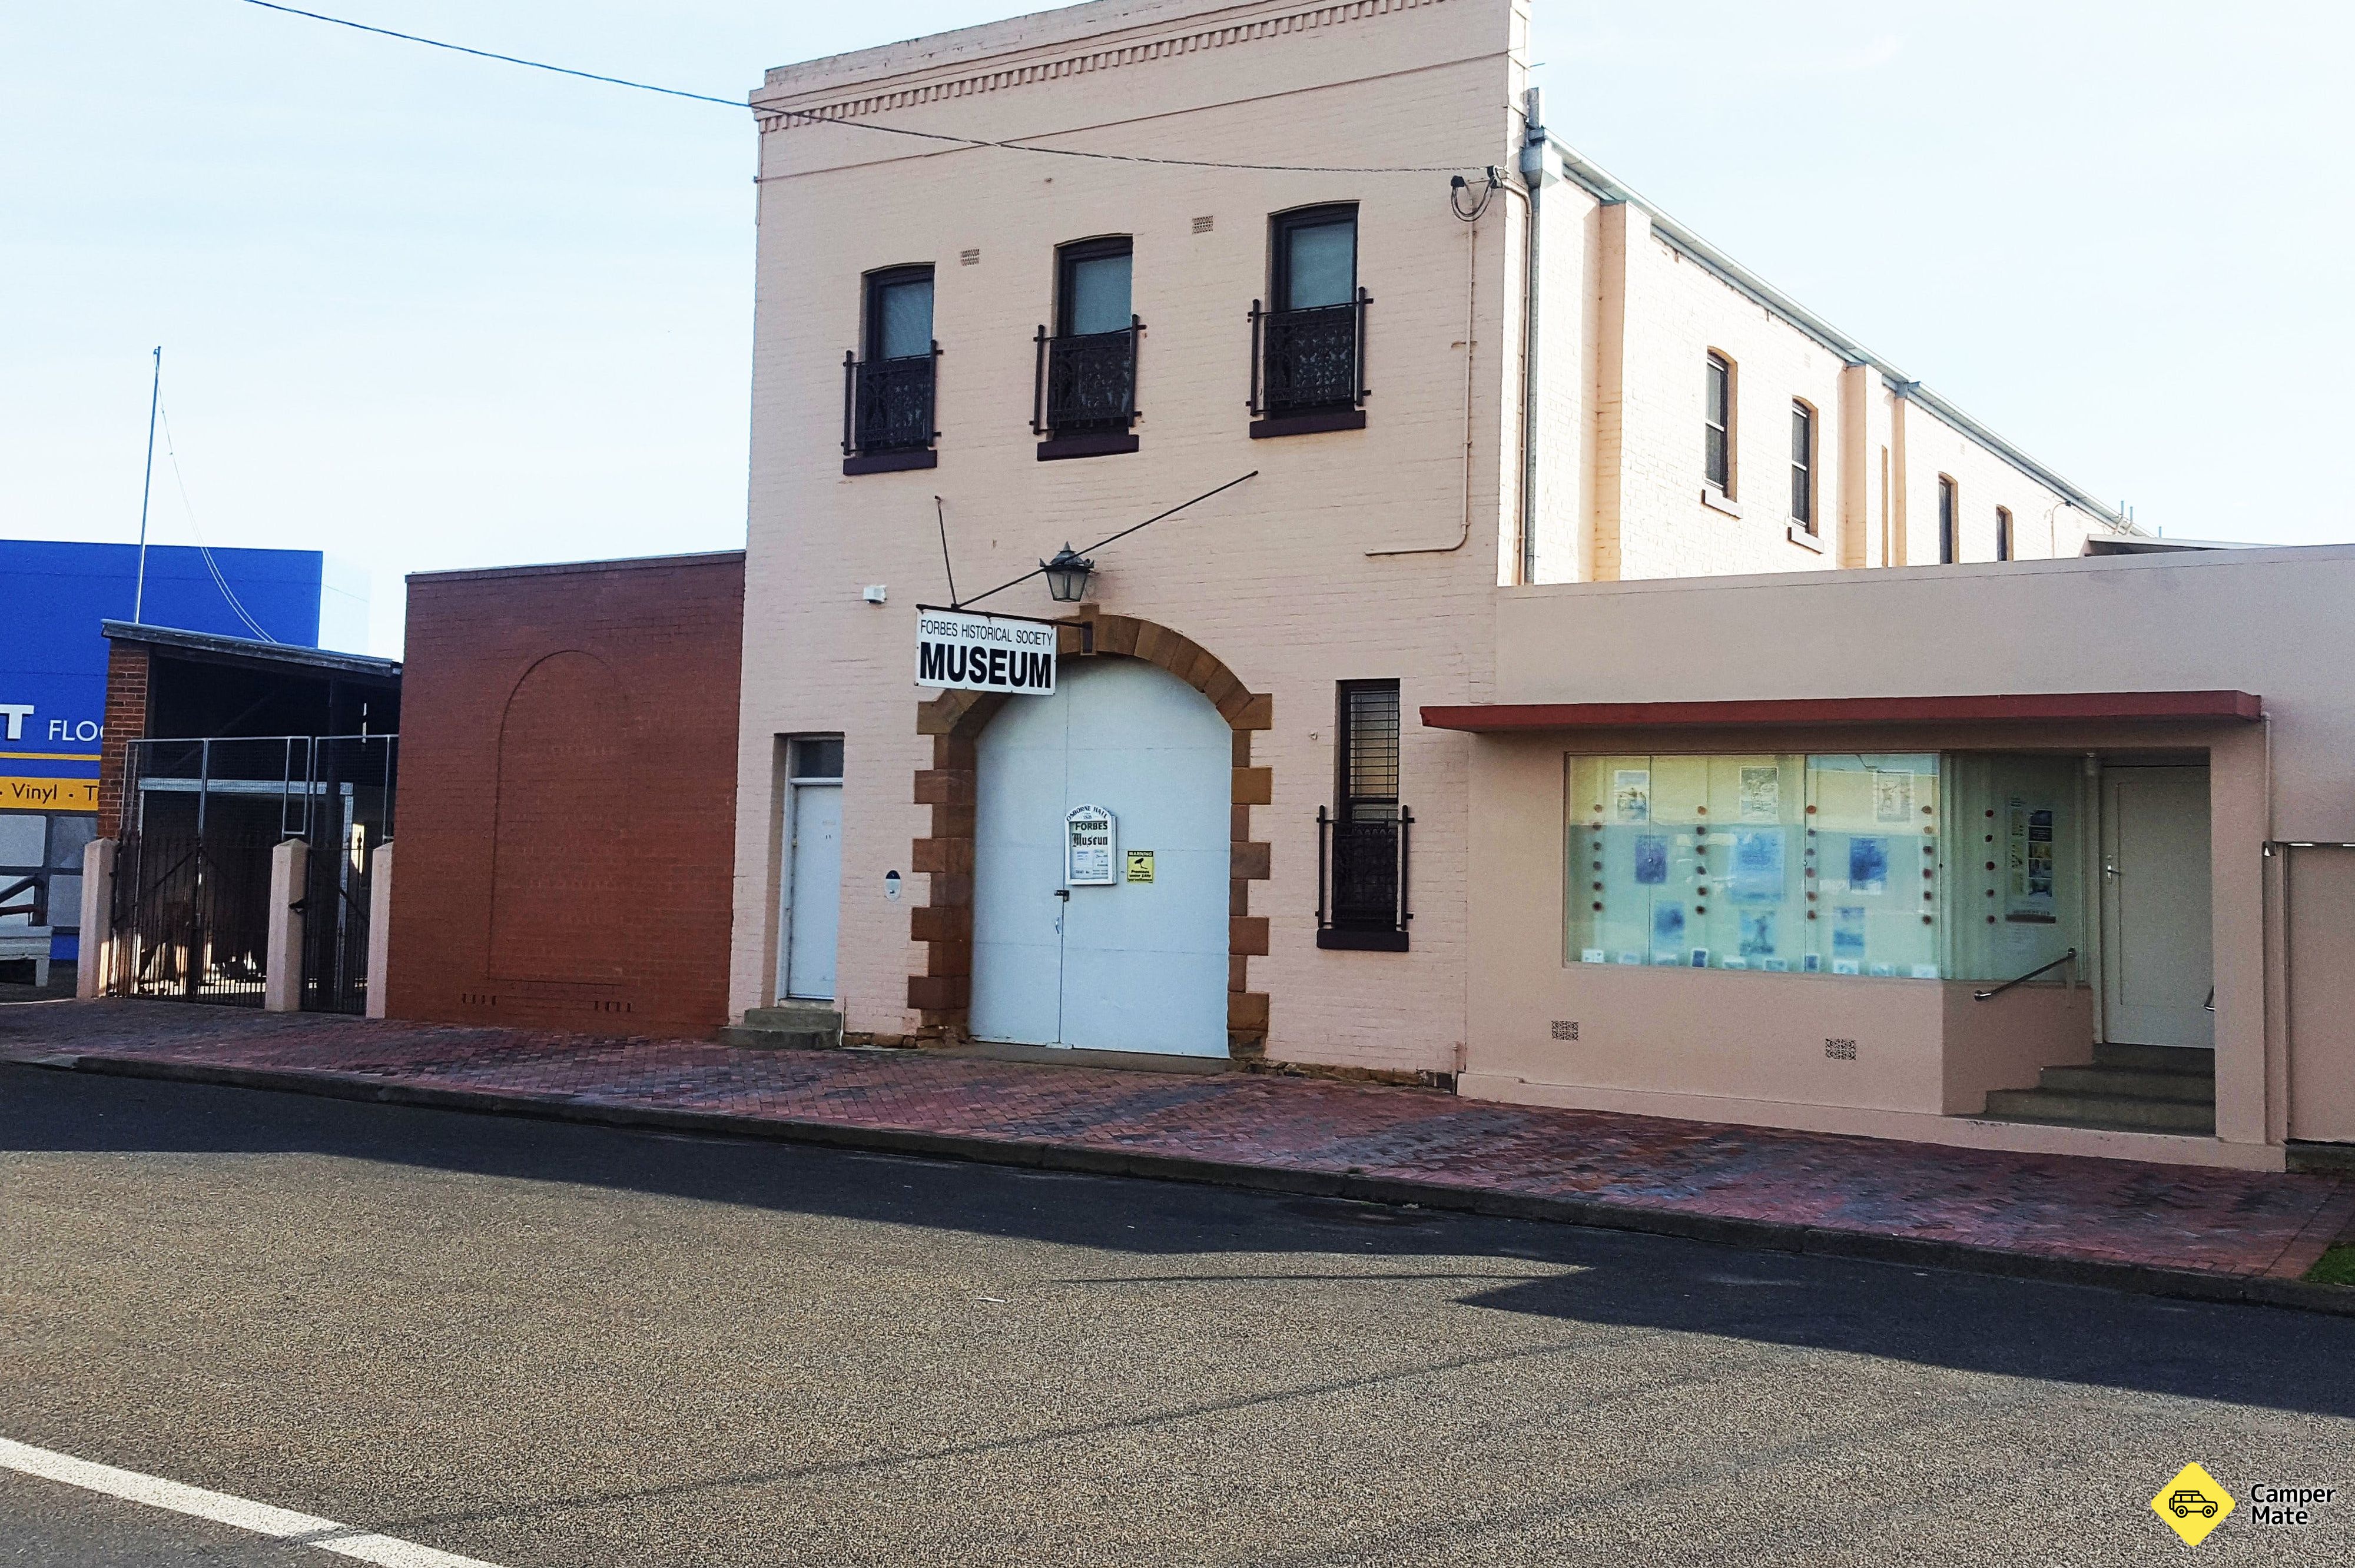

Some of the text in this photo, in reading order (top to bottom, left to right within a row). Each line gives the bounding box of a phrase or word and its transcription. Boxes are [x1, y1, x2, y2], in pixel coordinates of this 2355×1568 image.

[920, 619, 1053, 646] FORBES HISTORICAL SOCIETY
[920, 642, 1052, 689] MUSEUM
[48, 719, 104, 742] FLO
[12, 783, 57, 804] Vinyl
[1075, 822, 1107, 830] FORBES
